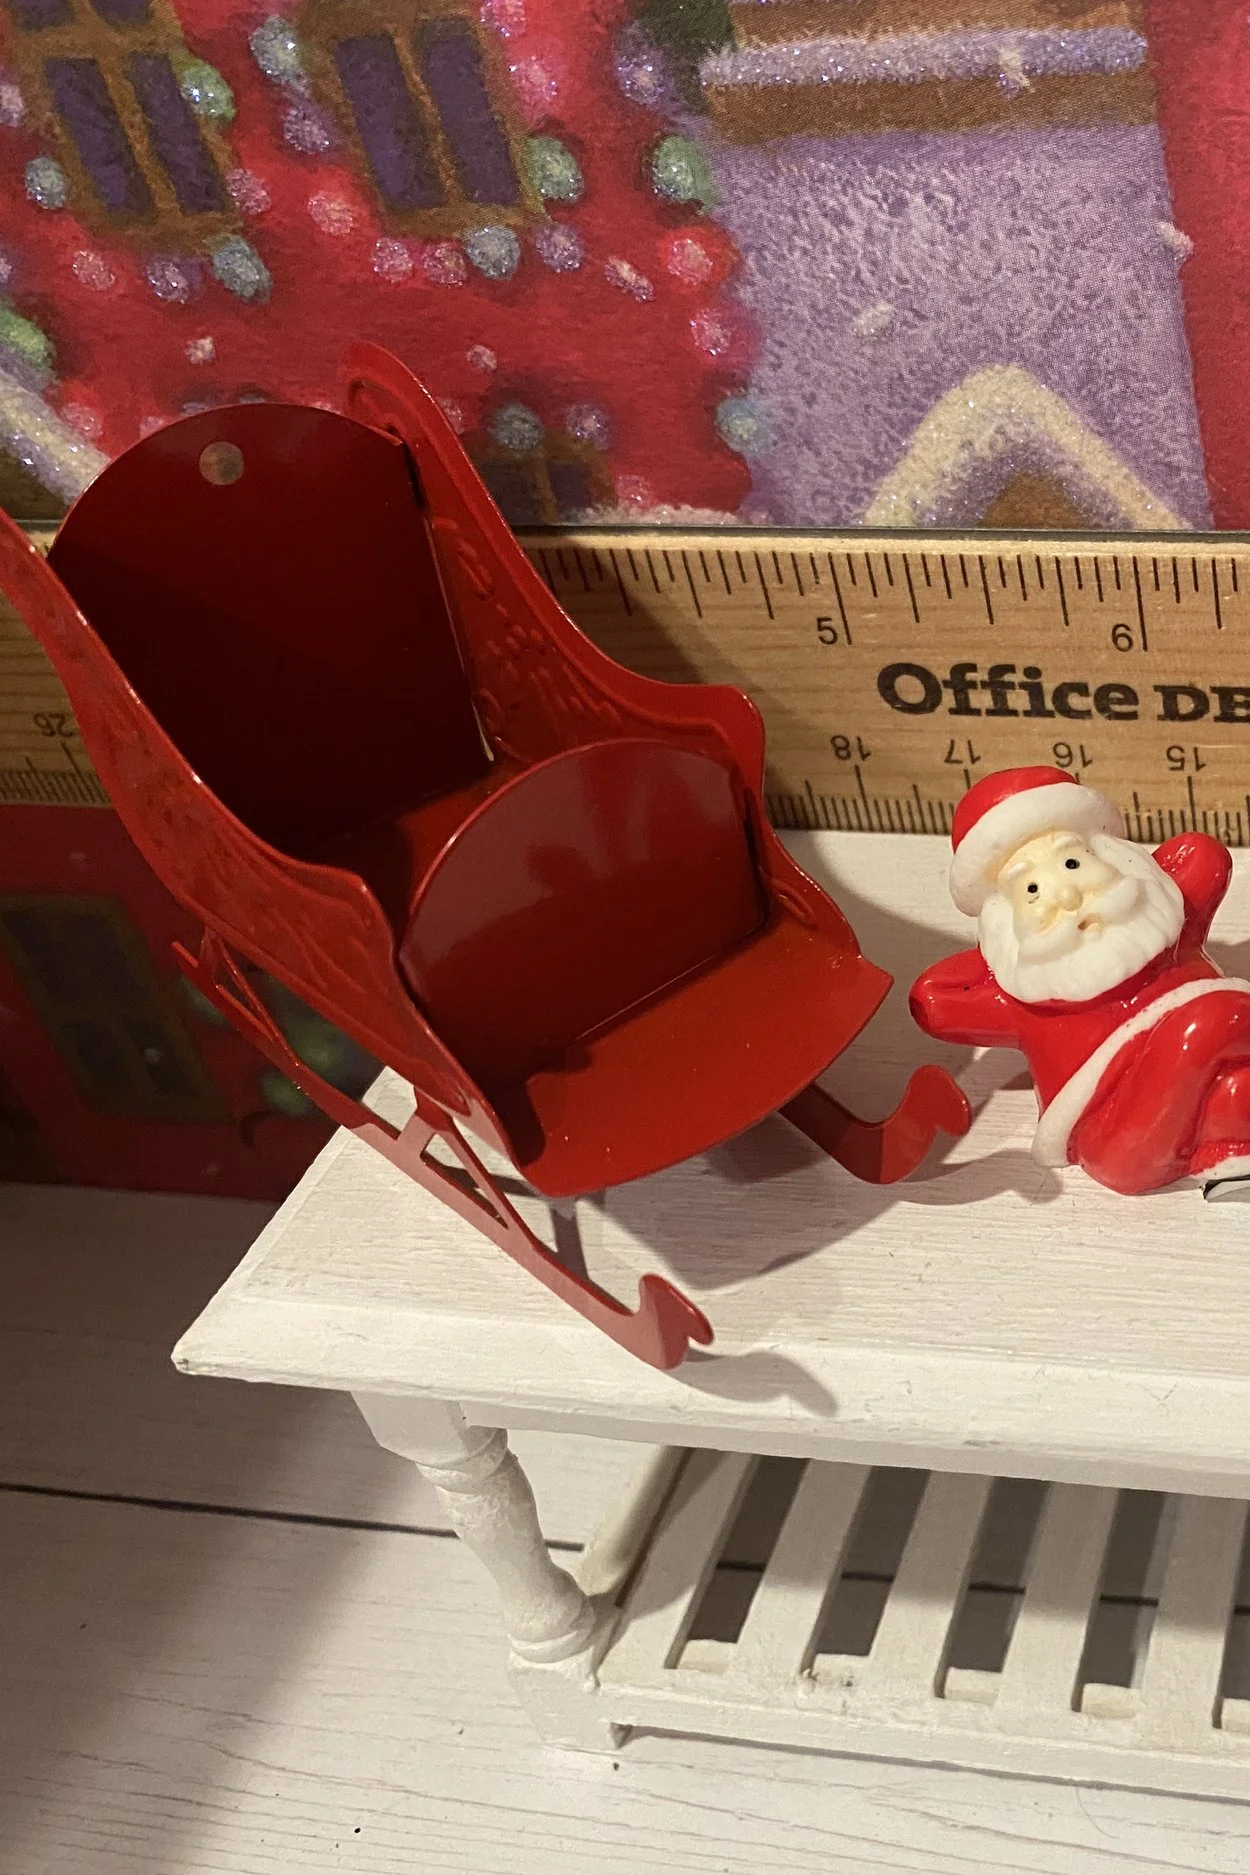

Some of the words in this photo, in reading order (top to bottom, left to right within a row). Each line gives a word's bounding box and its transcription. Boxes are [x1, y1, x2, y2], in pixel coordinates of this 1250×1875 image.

[816, 616, 839, 645] 5
[1110, 623, 1133, 651] 6
[877, 662, 1140, 721] Office
[831, 734, 872, 761] 18
[944, 739, 982, 766] 17
[1052, 742, 1094, 768] 16
[1166, 746, 1207, 773] 15
